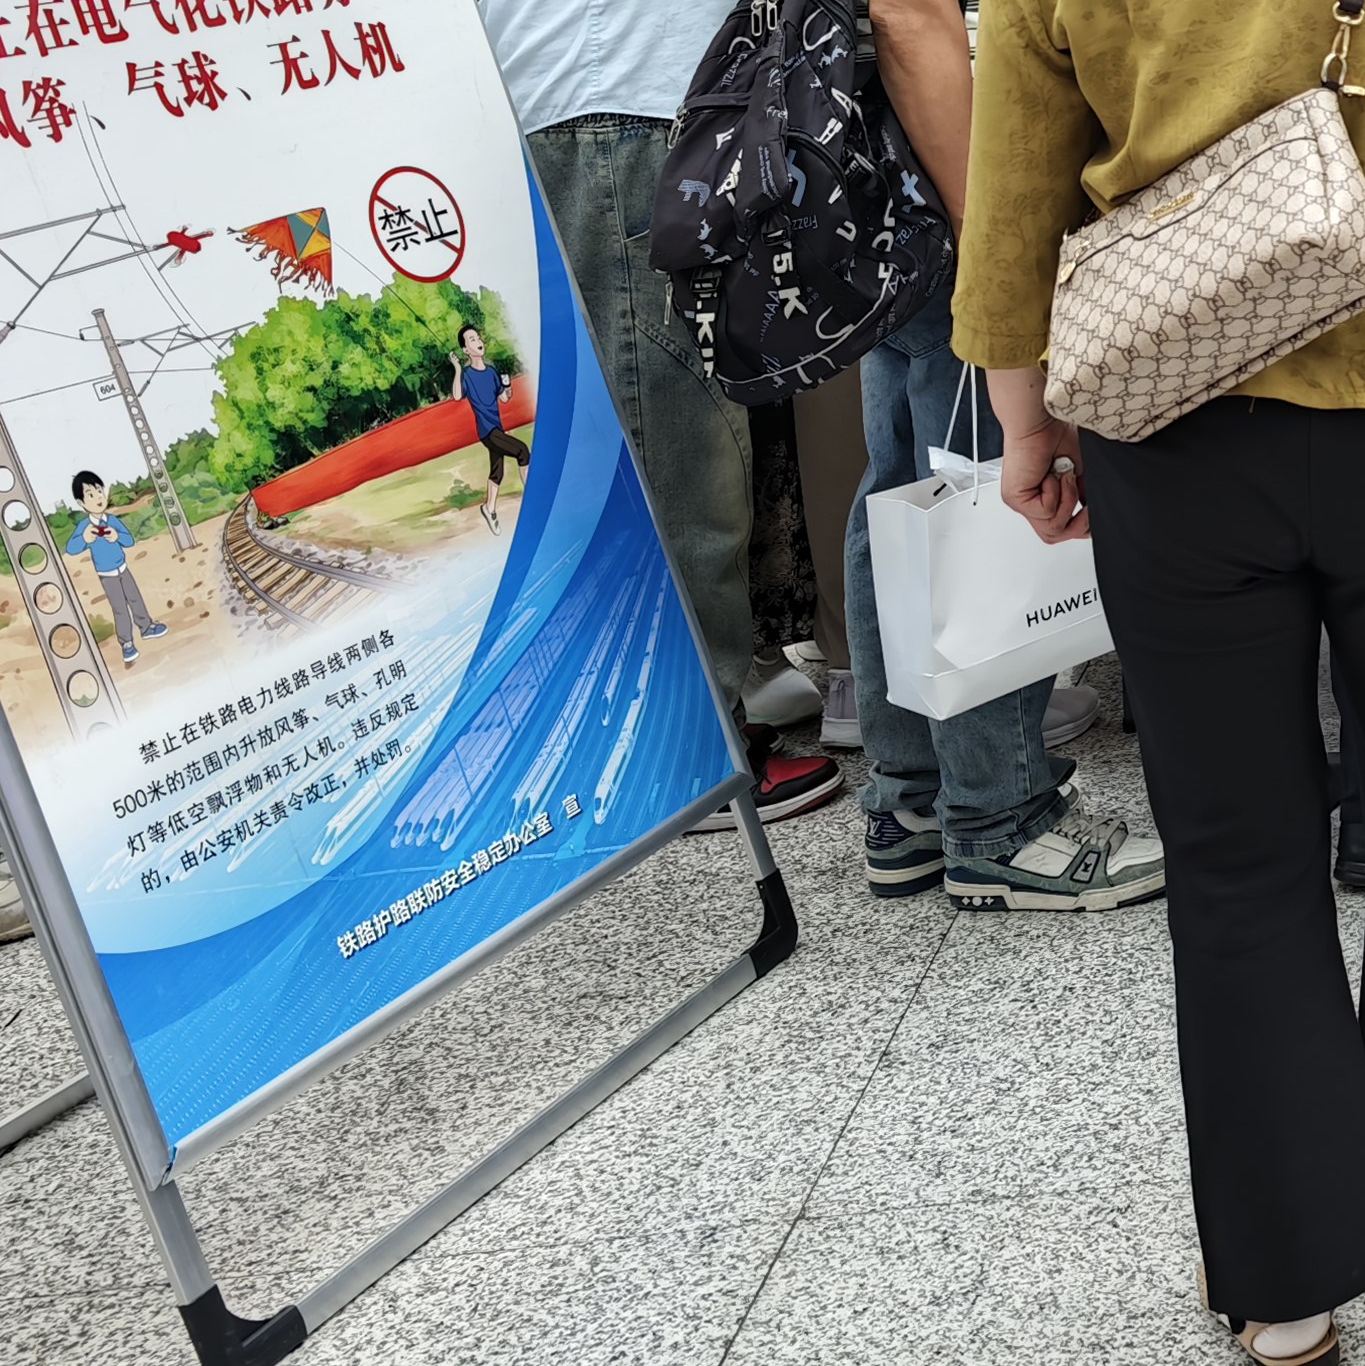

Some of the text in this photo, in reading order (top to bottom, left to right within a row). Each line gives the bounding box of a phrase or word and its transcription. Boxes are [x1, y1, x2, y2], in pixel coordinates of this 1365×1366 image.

[379, 199, 458, 254] 禁止
[99, 383, 116, 396] 604
[1025, 588, 1098, 627] HUAWEI
[139, 628, 396, 765] 禁止在铁路电力线路导线两侧各
[336, 794, 583, 960] 铁路护路联防安全稳定办公室 宣
